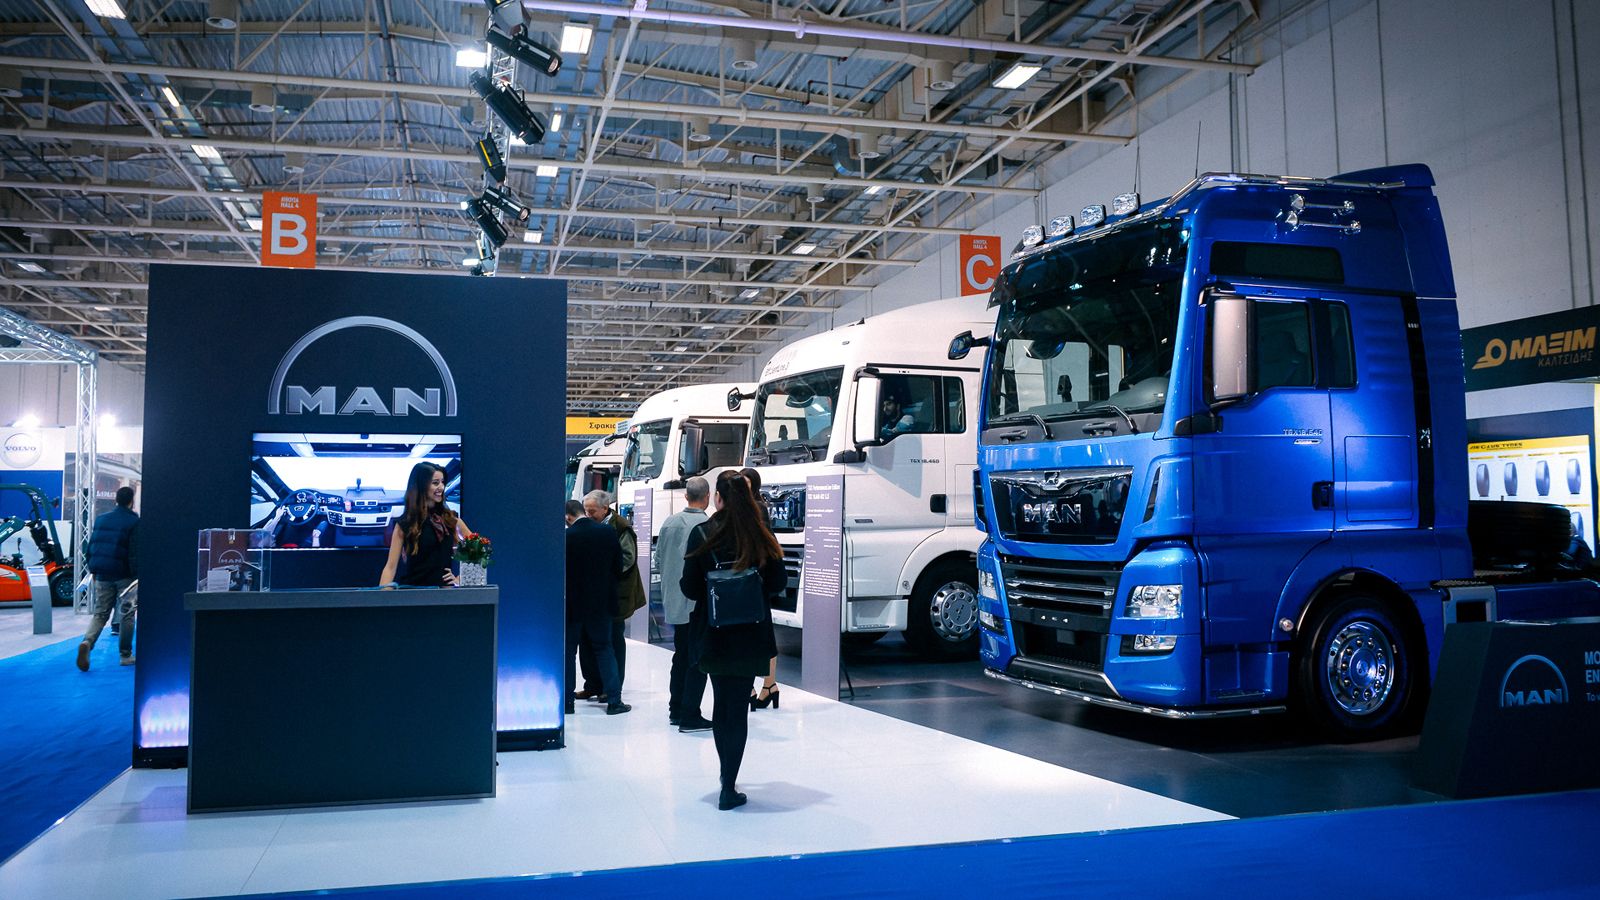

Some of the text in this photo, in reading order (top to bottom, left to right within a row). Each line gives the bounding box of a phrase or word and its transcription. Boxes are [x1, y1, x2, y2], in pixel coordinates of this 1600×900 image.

[271, 213, 308, 255] B
[966, 254, 994, 290] C
[1538, 351, 1594, 367] ΚΑΛΤΣΙΔΗΣ
[286, 385, 441, 417] MAN
[767, 507, 788, 521] AN
[1023, 503, 1082, 524] MAN
[1505, 688, 1563, 707] MAN
